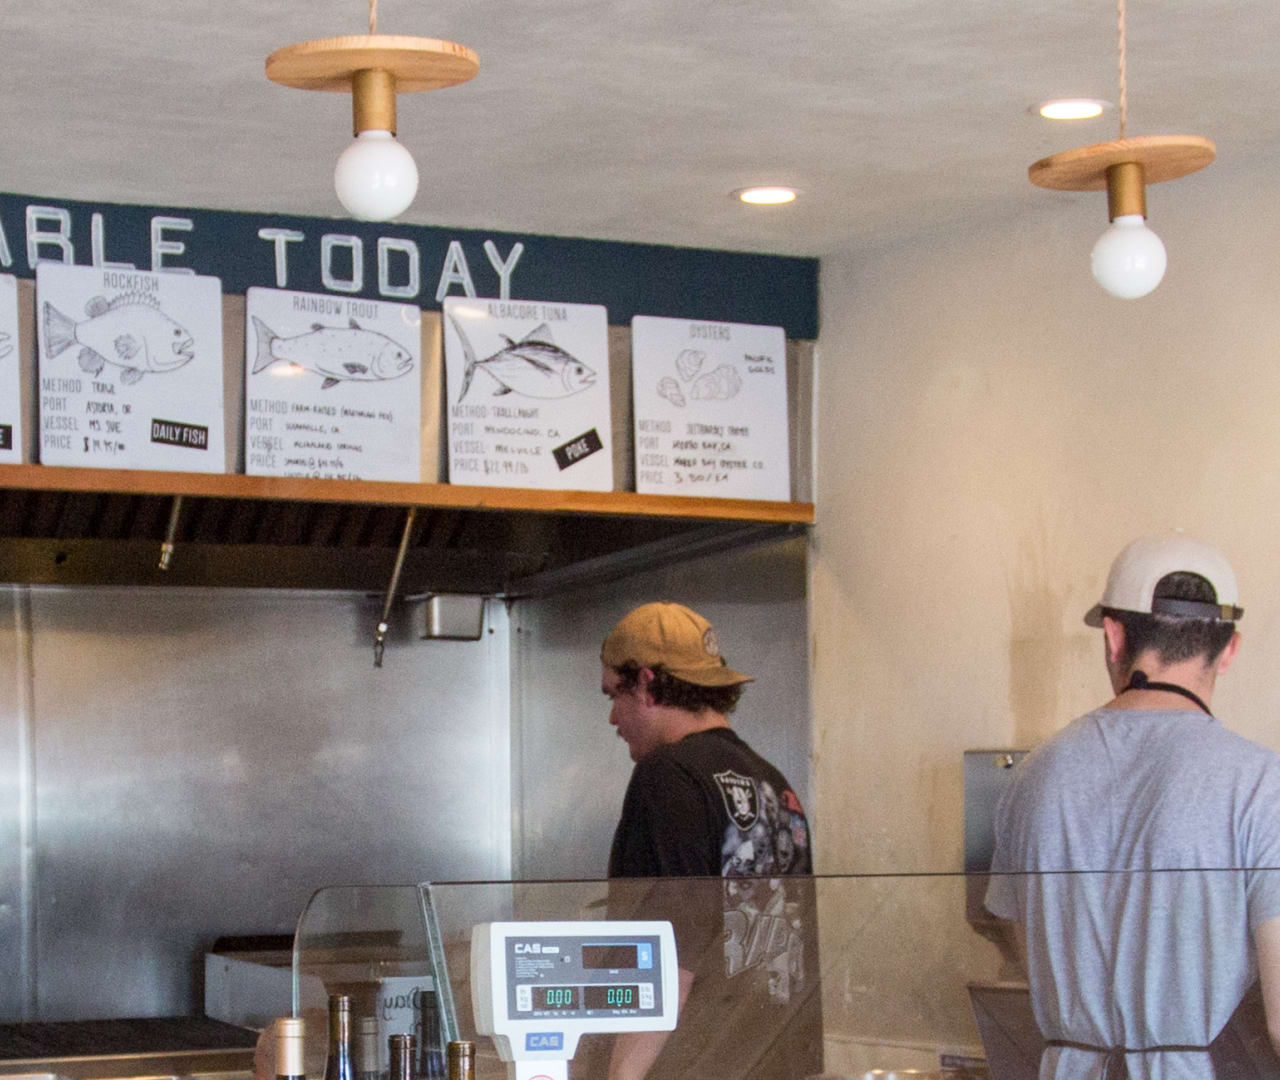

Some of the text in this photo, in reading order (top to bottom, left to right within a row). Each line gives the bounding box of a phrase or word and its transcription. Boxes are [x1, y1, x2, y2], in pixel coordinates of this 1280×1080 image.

[258, 227, 524, 300] TODAY
[104, 272, 159, 291] ROCKFISH
[293, 296, 379, 319] RAINBOW TROUT
[488, 304, 568, 321] ALBACORE TUNA
[689, 324, 731, 342] OYSTERS
[43, 379, 82, 393] METHOD
[43, 398, 66, 411] PORT
[250, 399, 288, 413] METHOD
[452, 405, 486, 418] METHOD
[44, 417, 79, 431] VESSEL
[250, 418, 273, 431] PORT
[452, 423, 473, 435] PORT
[548, 429, 560, 438] CA
[638, 419, 671, 433] METHOD
[153, 423, 206, 444] DAILY FISH
[44, 435, 71, 449] PRICE
[250, 436, 283, 451] VESSEL
[453, 441, 485, 454] VESSEL
[565, 438, 589, 460] POKE
[638, 437, 659, 449] PORT
[250, 454, 276, 468] PRICE
[454, 458, 478, 472] PRICE
[640, 454, 669, 468] VESSEL
[640, 470, 663, 484] PRICE
[515, 944, 540, 953] CAS
[529, 1036, 559, 1047] CAS
